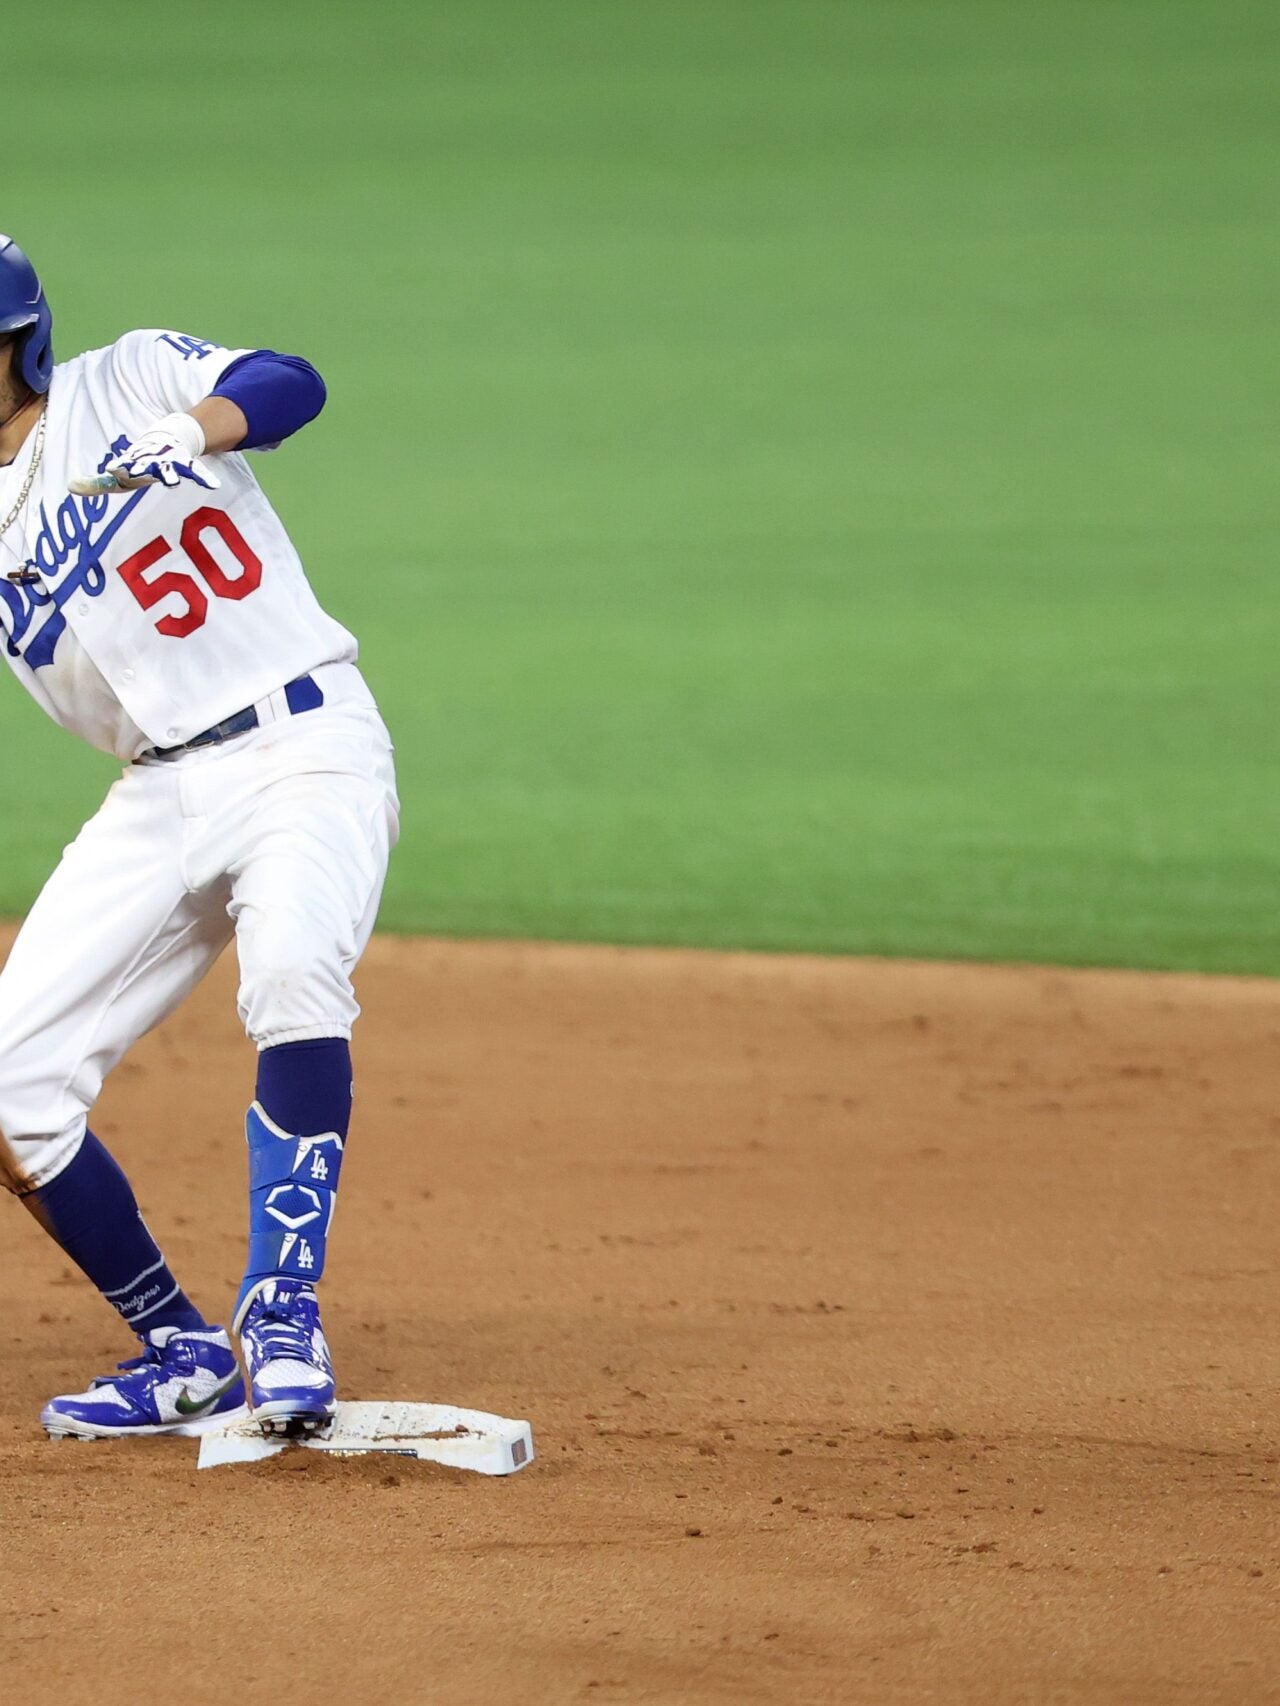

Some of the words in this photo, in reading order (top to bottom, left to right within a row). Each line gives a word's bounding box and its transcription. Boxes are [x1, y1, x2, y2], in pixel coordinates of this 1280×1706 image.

[154, 333, 221, 361] LA
[116, 506, 263, 638] 50
[310, 1149, 329, 1181] LA
[297, 1238, 314, 1269] LA
